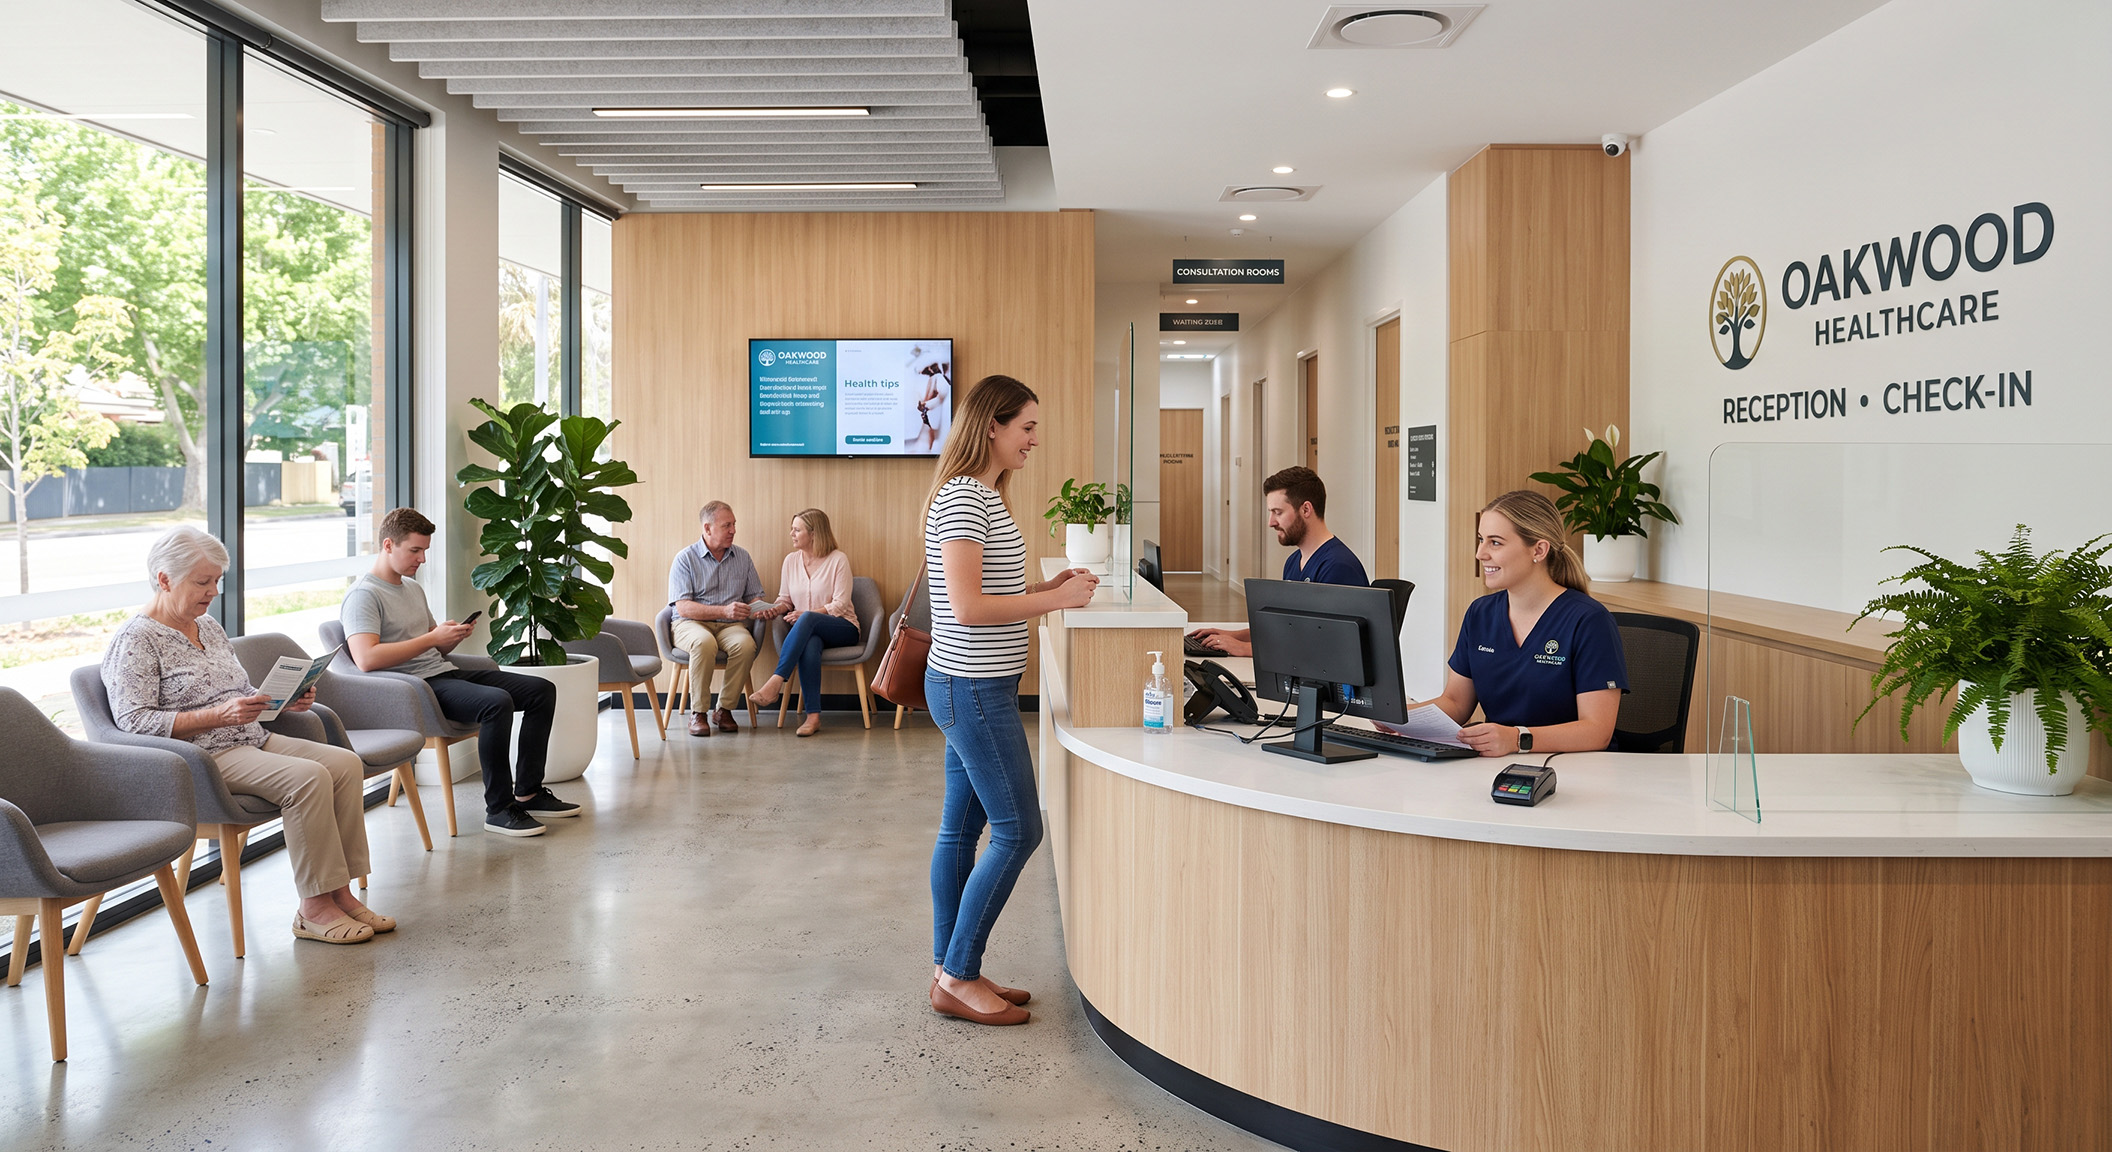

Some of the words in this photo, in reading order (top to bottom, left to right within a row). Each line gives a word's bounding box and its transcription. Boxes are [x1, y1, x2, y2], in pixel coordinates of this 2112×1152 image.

[1177, 268, 1245, 276] CONSULTATION
[1246, 268, 1280, 276] ROOMS
[1781, 202, 2055, 310] OAKWOOD
[1815, 289, 1999, 346] HEALTHCARE
[778, 351, 827, 360] OAKWOOD
[844, 379, 878, 388] Health
[881, 379, 900, 389] tips
[1723, 387, 1847, 424] RECEPTION
[1883, 369, 2032, 415] CHECK-IN
